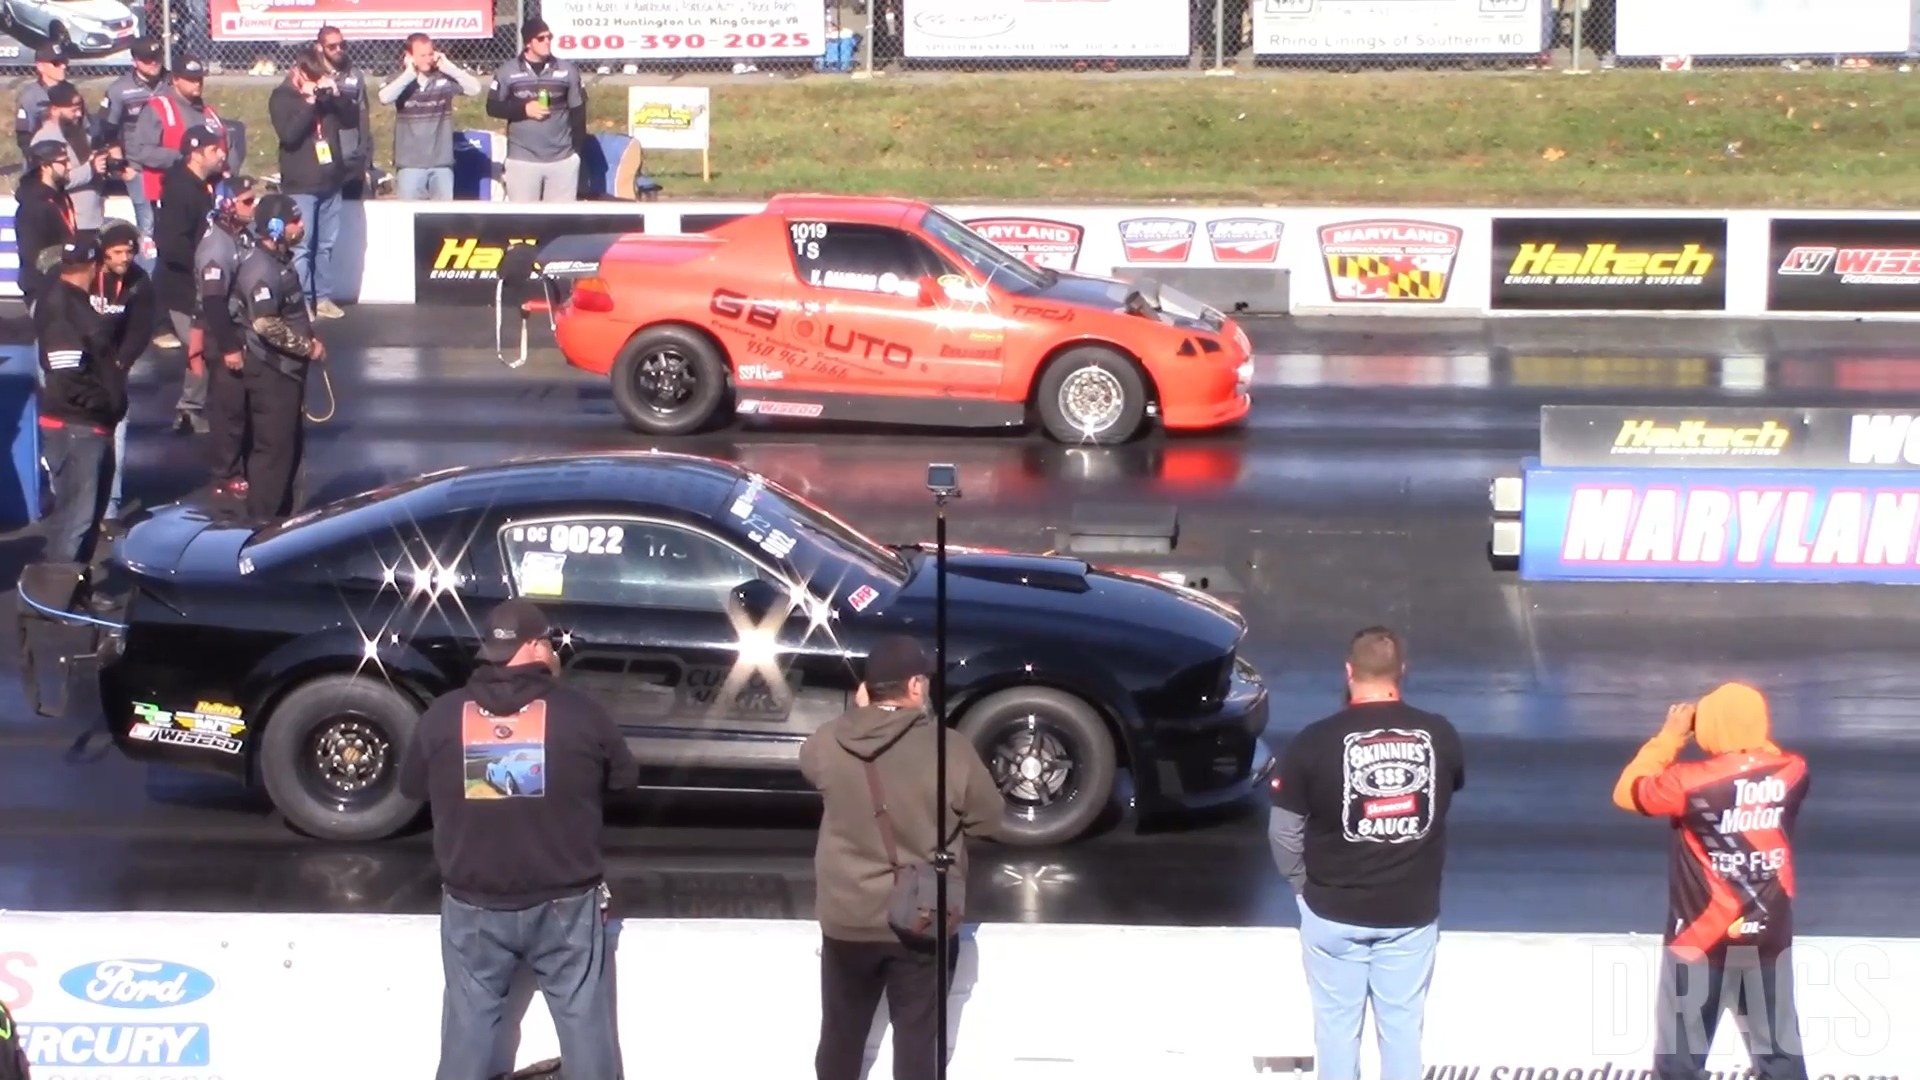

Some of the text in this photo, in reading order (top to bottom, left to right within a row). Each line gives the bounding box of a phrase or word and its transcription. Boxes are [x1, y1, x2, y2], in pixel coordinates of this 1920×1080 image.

[614, 17, 684, 28] Huntington
[710, 17, 737, 28] King
[741, 17, 781, 28] George
[557, 33, 811, 50] 800-390-2025
[1269, 33, 1524, 49] Rhino Linings of Southern MD
[790, 223, 828, 239] 1019
[975, 226, 1071, 242] ARYLAND
[1333, 227, 1449, 244] MARYLAND
[1508, 242, 1715, 276] Haltech
[430, 269, 475, 280] ENGINE
[1504, 275, 1703, 285] ENGINE MANAGEMENT SYSTEMS
[1614, 419, 1790, 448] Haltech
[1561, 484, 1920, 566] MARYLAN
[549, 525, 624, 554] 9022
[1733, 775, 1786, 807] Todo
[1357, 817, 1420, 836] SAUCE
[1719, 805, 1785, 834] Motor
[85, 960, 188, 1003] Ford
